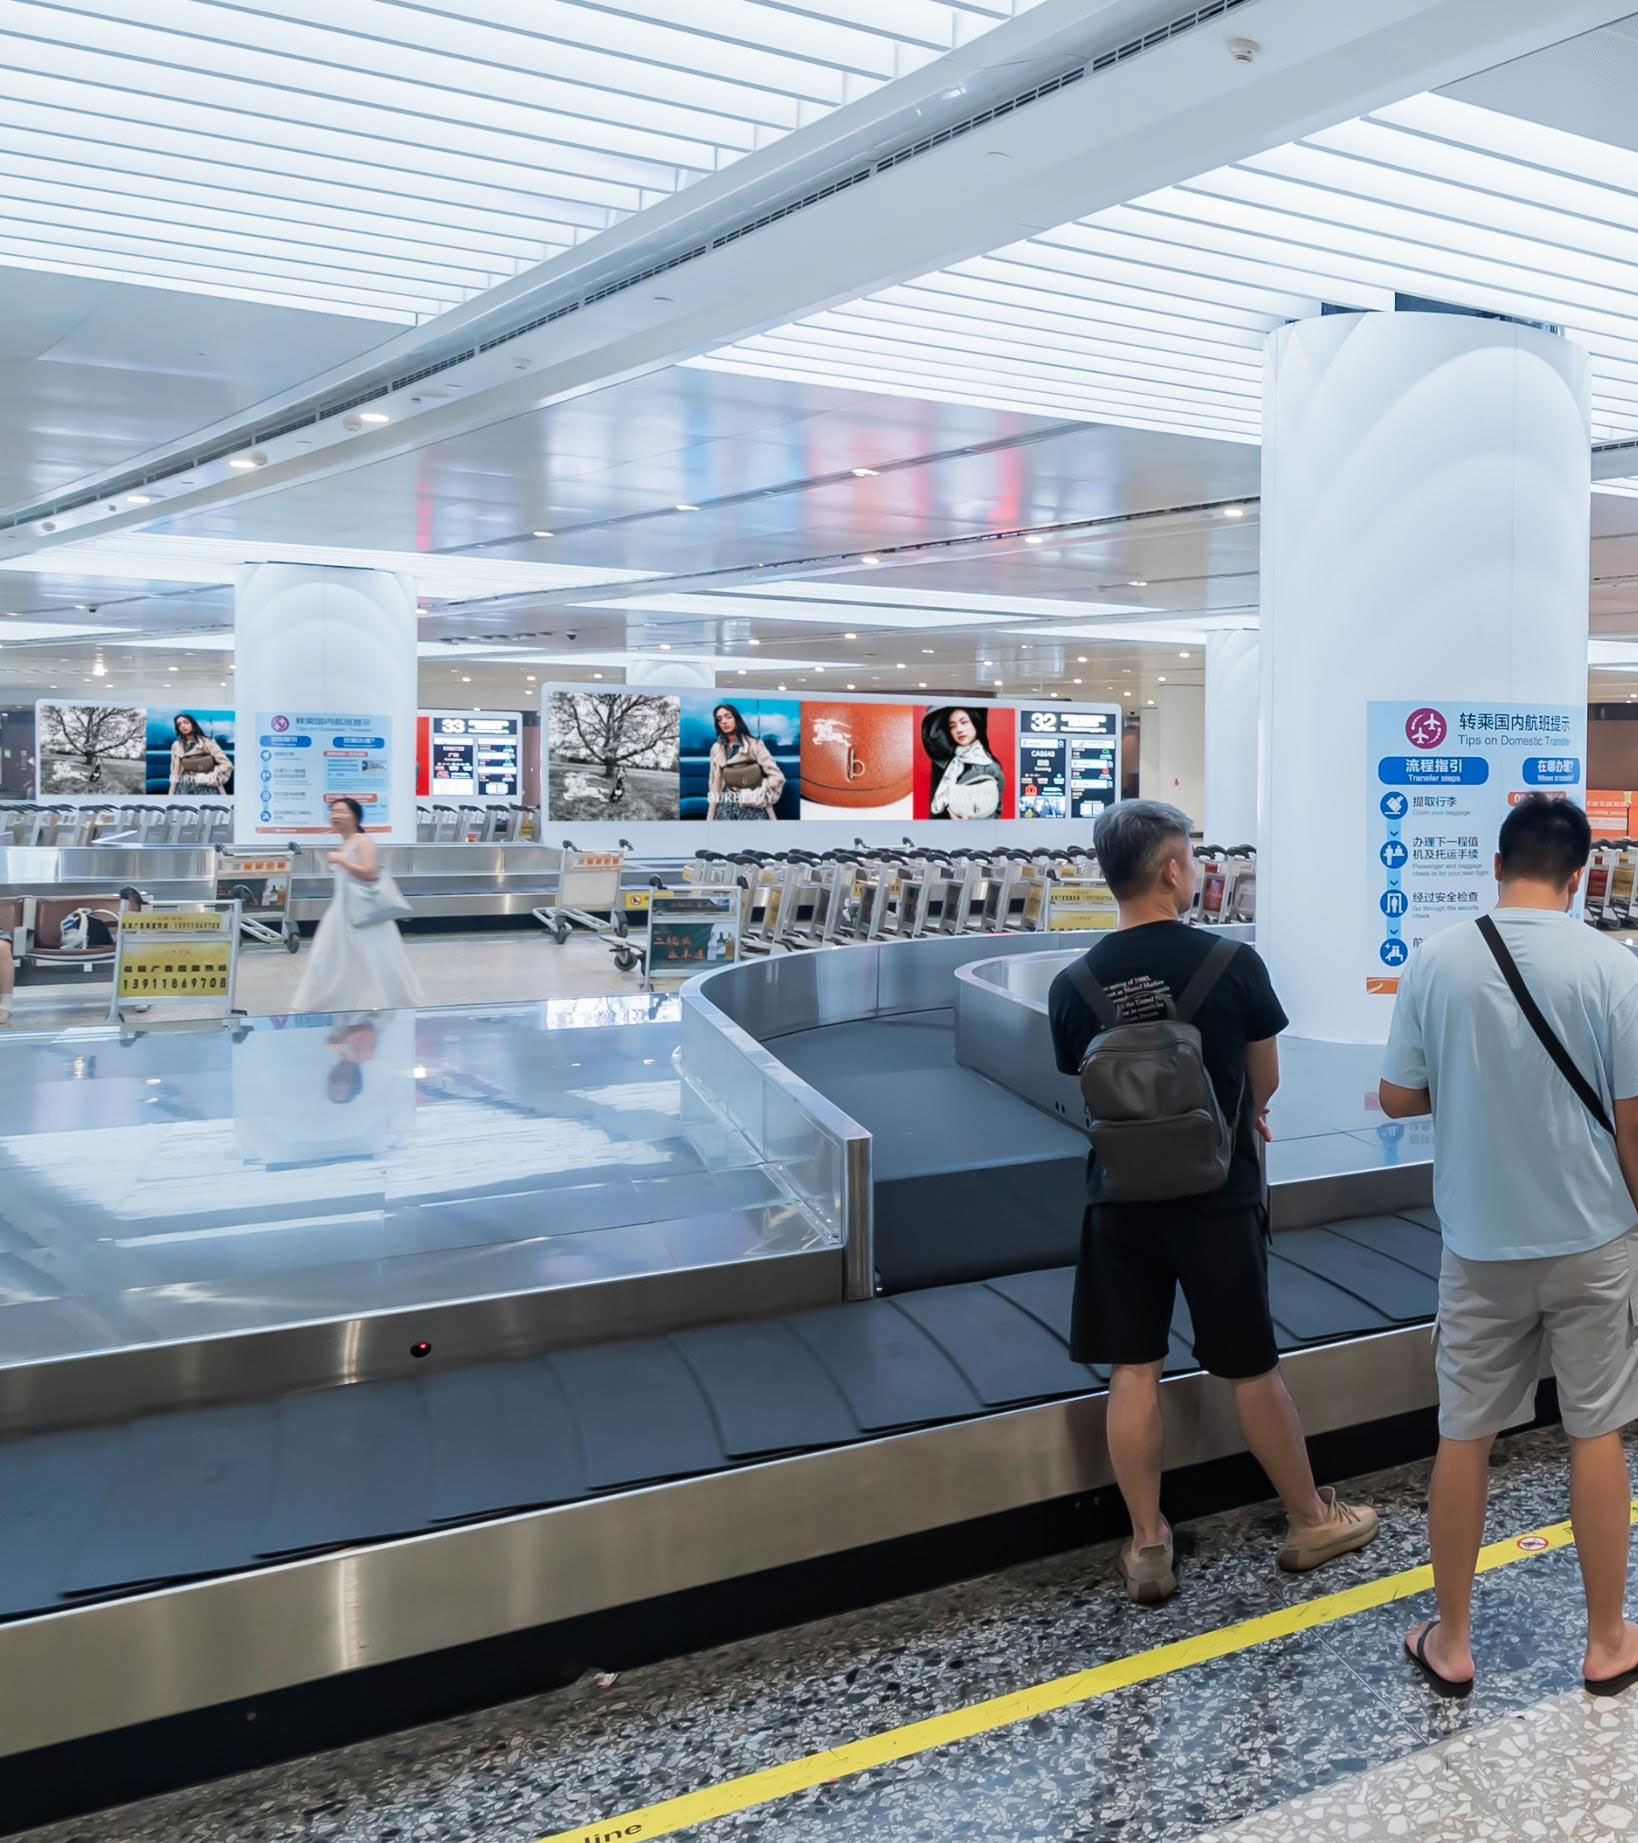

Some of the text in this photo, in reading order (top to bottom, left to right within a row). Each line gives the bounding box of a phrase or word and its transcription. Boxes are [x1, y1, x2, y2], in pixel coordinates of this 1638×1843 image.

[442, 719, 465, 733] 33
[1031, 713, 1056, 732] 32
[1459, 712, 1570, 732] 转乘国内航班提示
[1458, 735, 1481, 747] Tips
[1485, 737, 1497, 745] on
[1501, 735, 1544, 746] Domestic
[1405, 759, 1462, 773] 流程指引
[1408, 774, 1440, 782] Transfer
[1413, 796, 1457, 807] 提取行李
[1413, 836, 1478, 847] 办理下一程值
[1413, 849, 1478, 860] 机及托运手续
[1413, 891, 1478, 903] 经过安全检查
[123, 977, 227, 990] 13911869708
[585, 1824, 642, 1843] line
